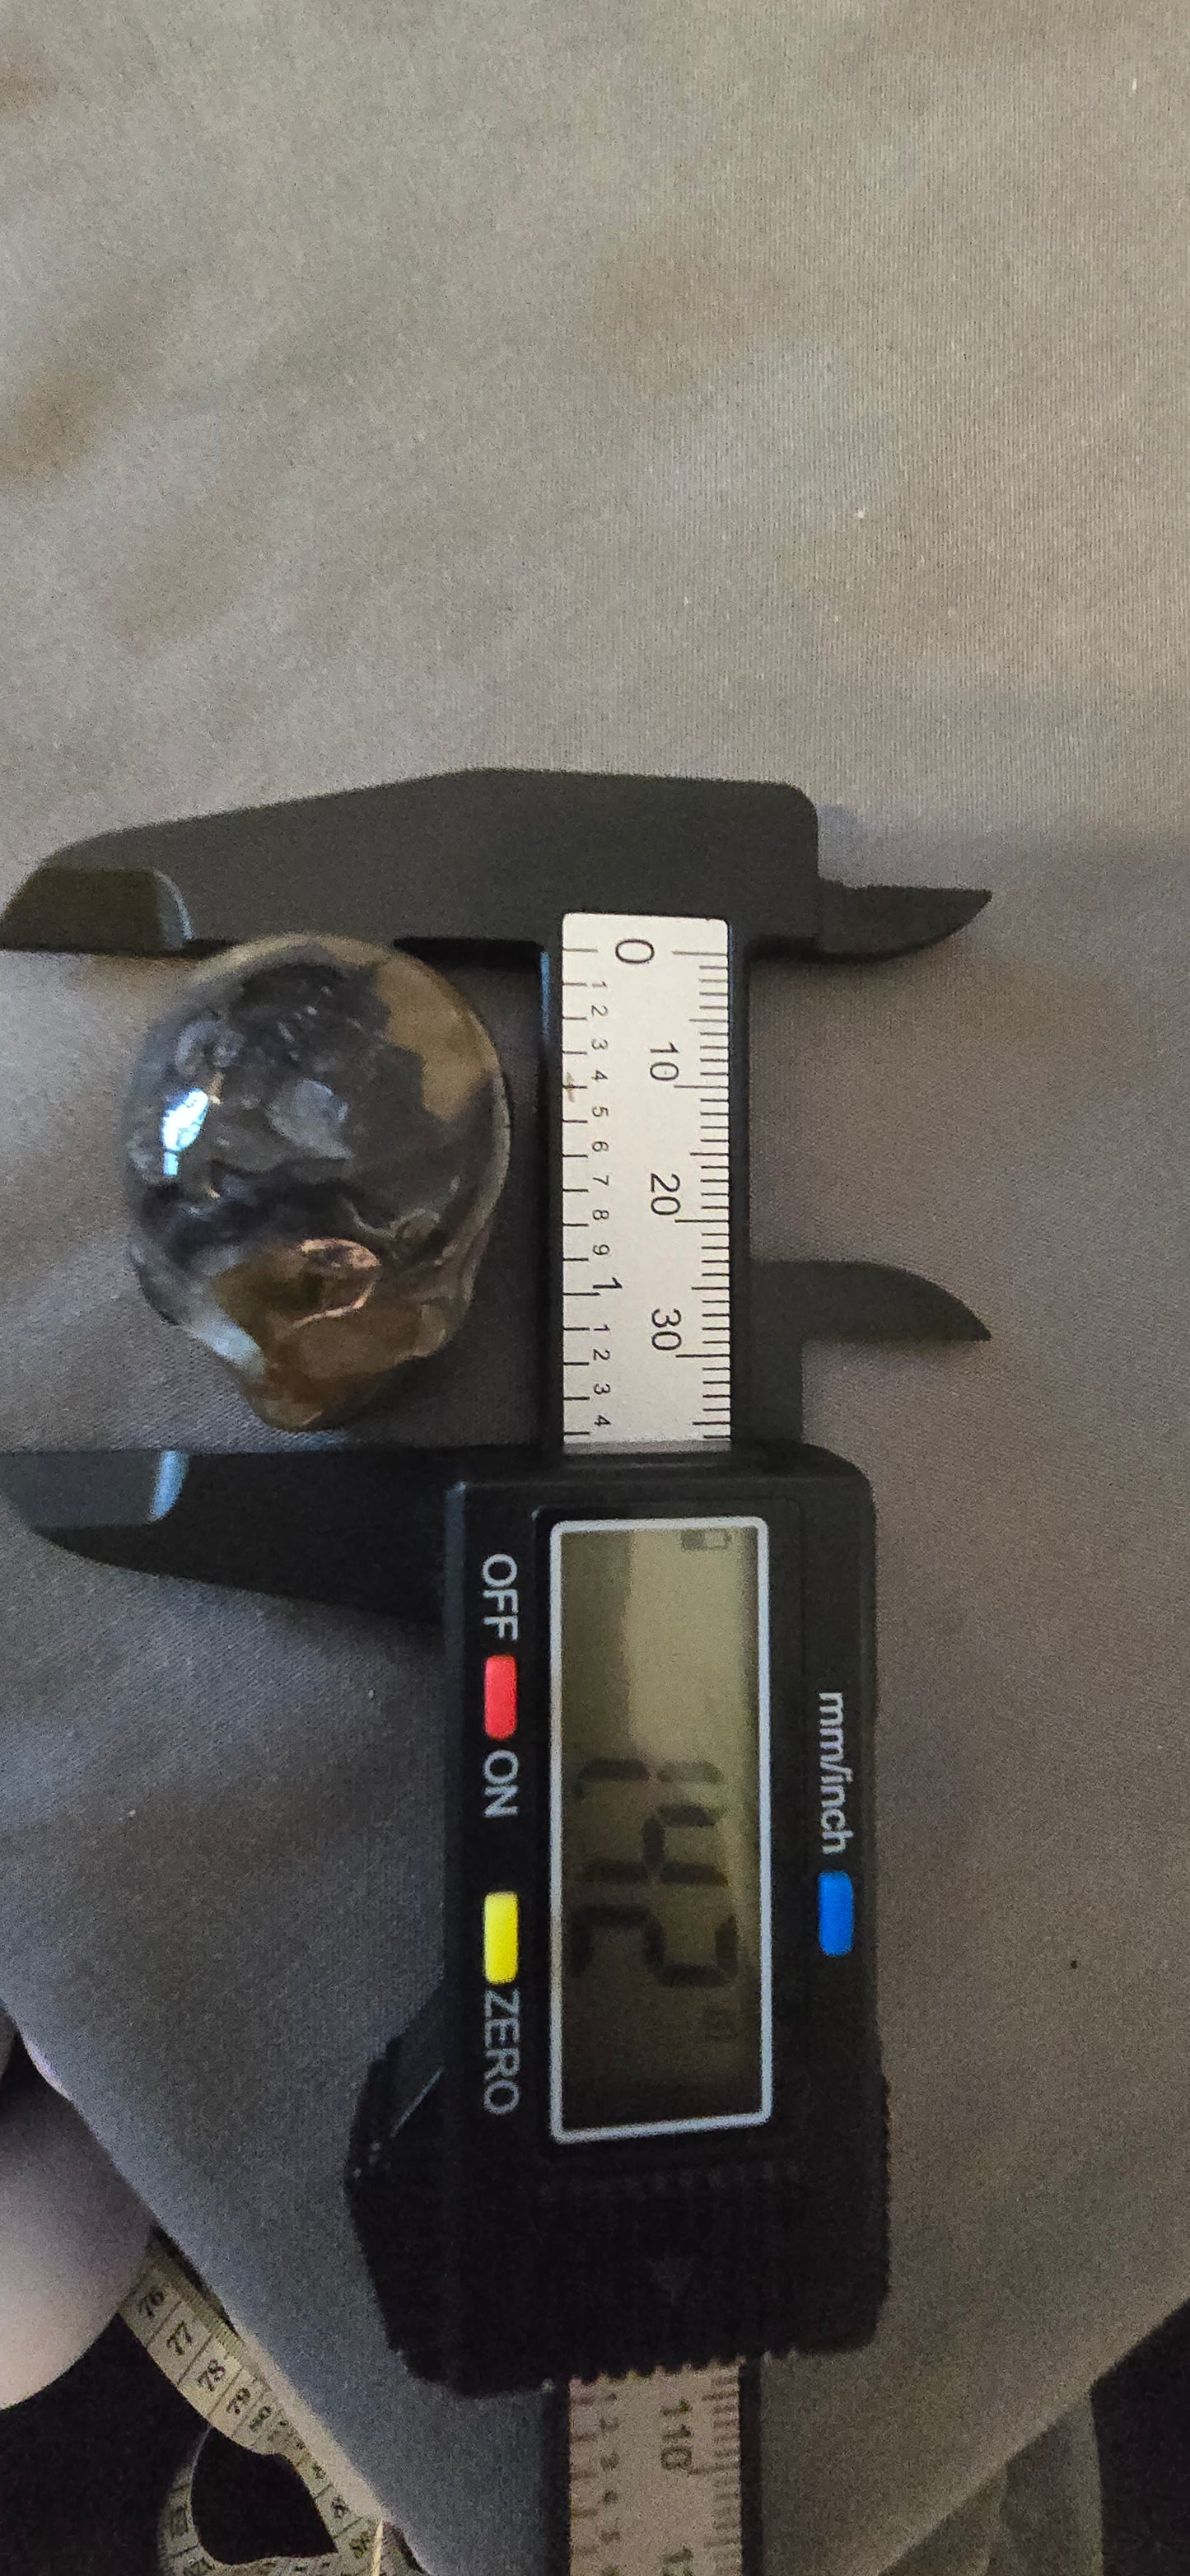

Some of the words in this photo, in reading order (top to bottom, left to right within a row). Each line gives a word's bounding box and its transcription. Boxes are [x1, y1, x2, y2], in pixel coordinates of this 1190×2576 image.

[614, 936, 656, 967] 0
[591, 980, 609, 988] 1
[590, 1004, 609, 1017] 2
[590, 1038, 609, 1051] 3
[649, 1041, 680, 1082] 10
[590, 1069, 609, 1083] 4
[591, 1105, 609, 1118] 5
[590, 1141, 609, 1153] 6
[591, 1174, 609, 1187] 7
[650, 1172, 682, 1216] 20
[591, 1208, 610, 1221] 8
[591, 1244, 611, 1257] 9
[591, 1276, 623, 1291] 1
[592, 1323, 611, 1332] 1
[651, 1308, 683, 1351] 30
[592, 1348, 611, 1361] 2
[592, 1383, 612, 1396] 3
[593, 1414, 613, 1428] 4
[482, 1553, 519, 1640] OFF
[819, 1692, 854, 1855] mm/inch
[483, 1749, 519, 1817] ON
[483, 1990, 520, 2116] ZERO
[166, 2321, 193, 2356] 77
[198, 2359, 226, 2392] 78
[660, 2399, 693, 2471] 110
